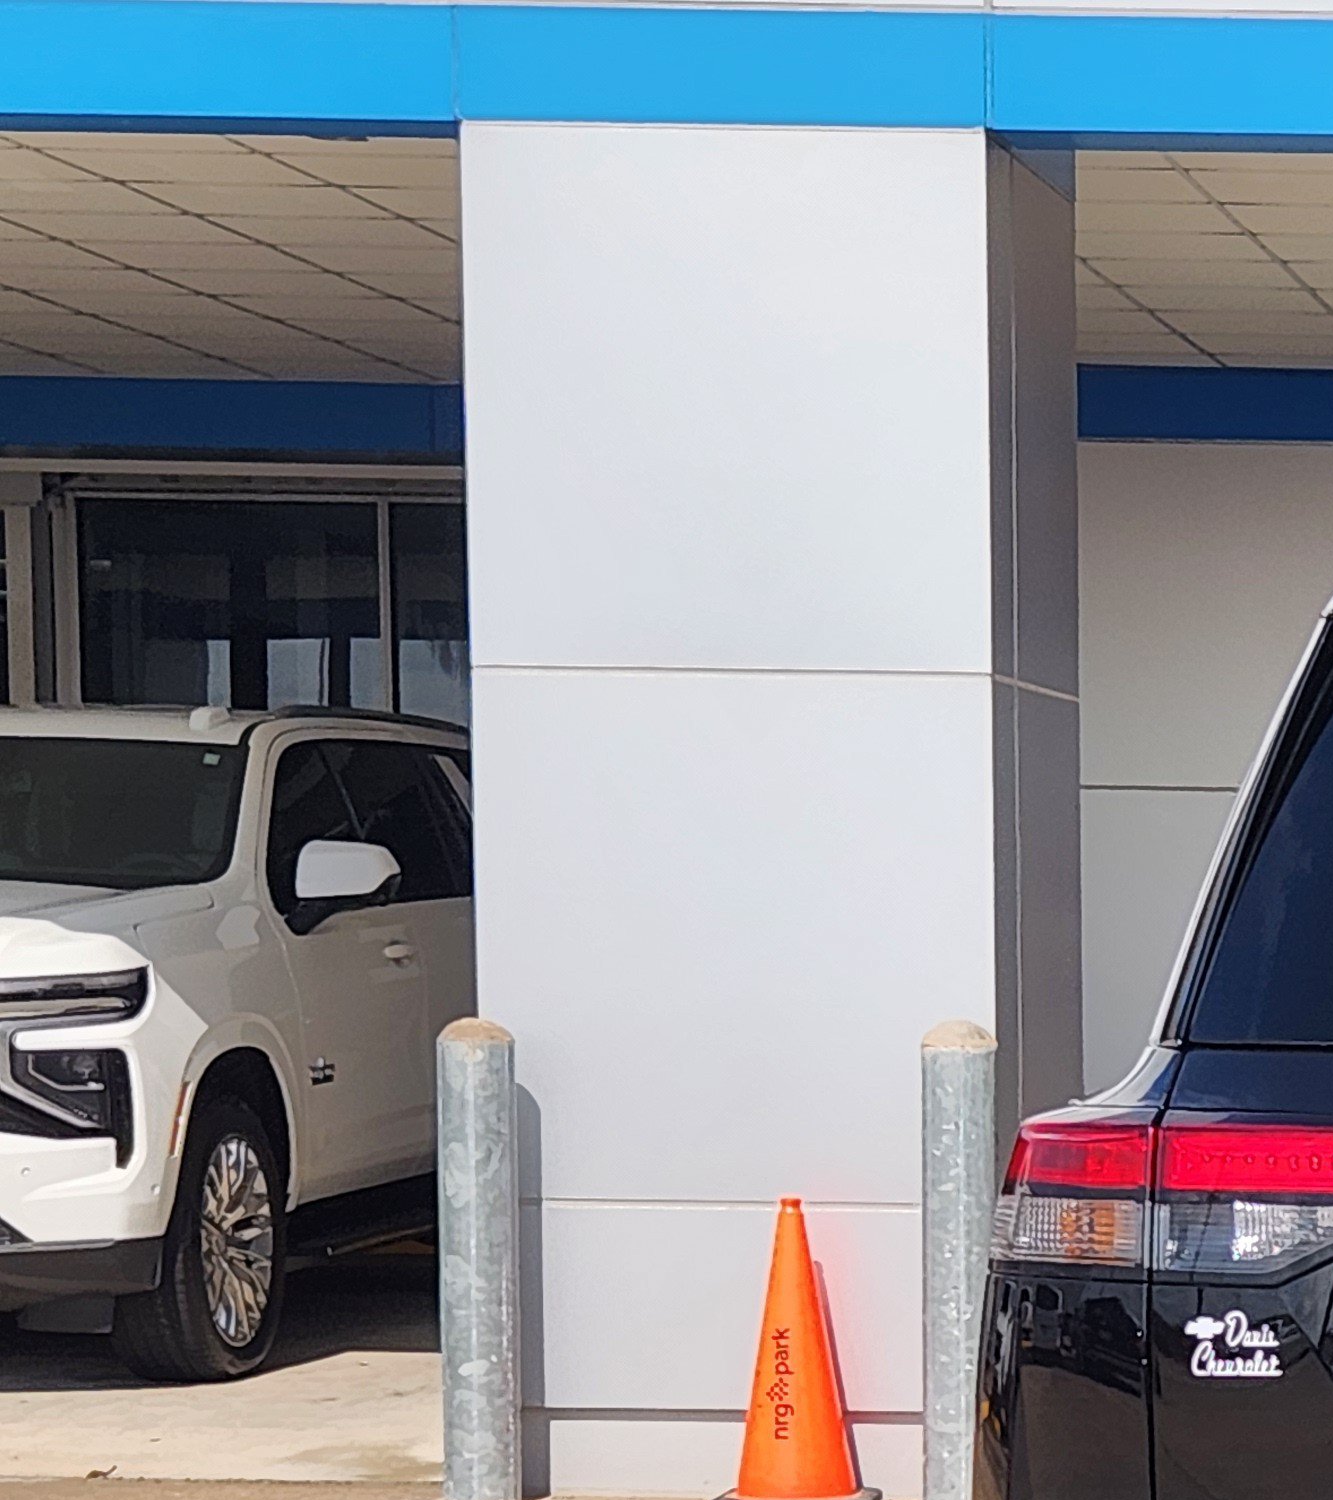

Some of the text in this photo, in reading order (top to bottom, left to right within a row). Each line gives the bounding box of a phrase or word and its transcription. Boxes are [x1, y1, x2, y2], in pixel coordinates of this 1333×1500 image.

[1224, 1309, 1280, 1347] Davis
[1191, 1340, 1284, 1377] Chevrolet
[771, 1328, 795, 1440] nrg park
